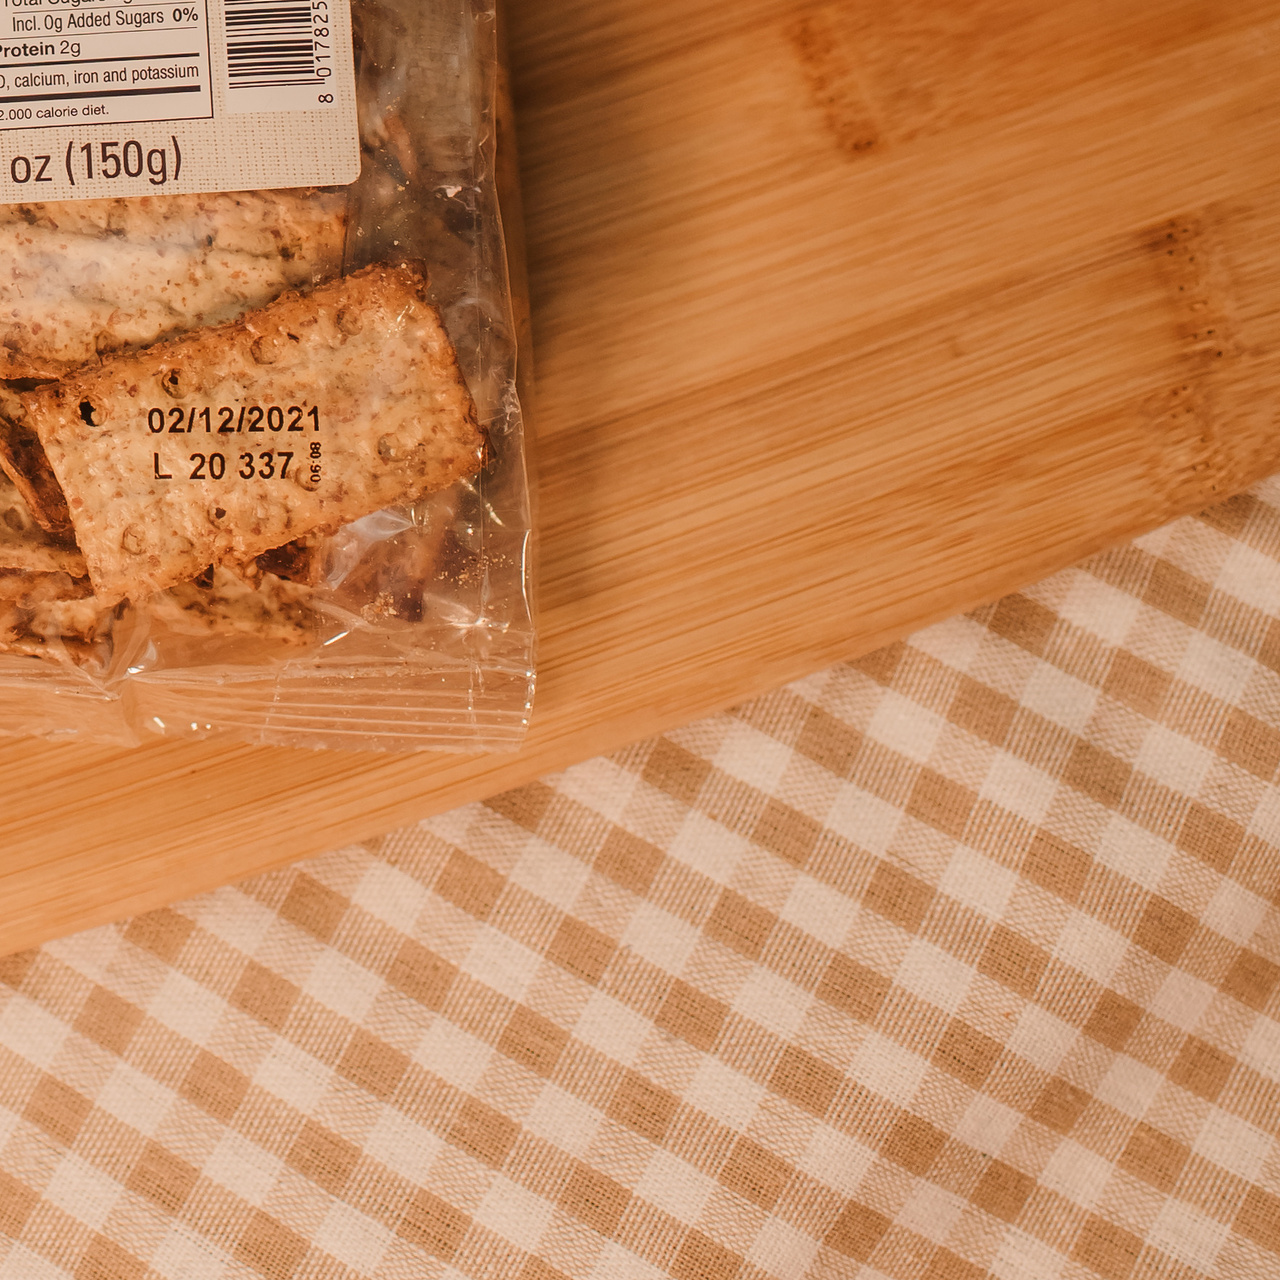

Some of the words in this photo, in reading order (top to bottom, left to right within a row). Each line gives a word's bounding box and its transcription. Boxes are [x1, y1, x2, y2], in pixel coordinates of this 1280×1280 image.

[12, 16, 41, 32] Incl.
[44, 14, 62, 32] 0g
[68, 12, 111, 29] Added
[116, 9, 164, 29] Sugars
[172, 7, 199, 22] 0%
[60, 40, 81, 58] 2g
[14, 69, 70, 89] calcium,
[74, 69, 99, 84] iron
[103, 67, 128, 82] and
[132, 63, 199, 83] potassium
[318, 92, 334, 104] 8
[36, 105, 78, 119] calorie
[82, 103, 109, 116] diet.
[10, 154, 53, 184] oz
[65, 135, 182, 186] (150g)
[148, 406, 320, 433] 02/12/2021
[154, 452, 173, 479] L
[189, 452, 225, 480] 20
[239, 451, 294, 479] 337
